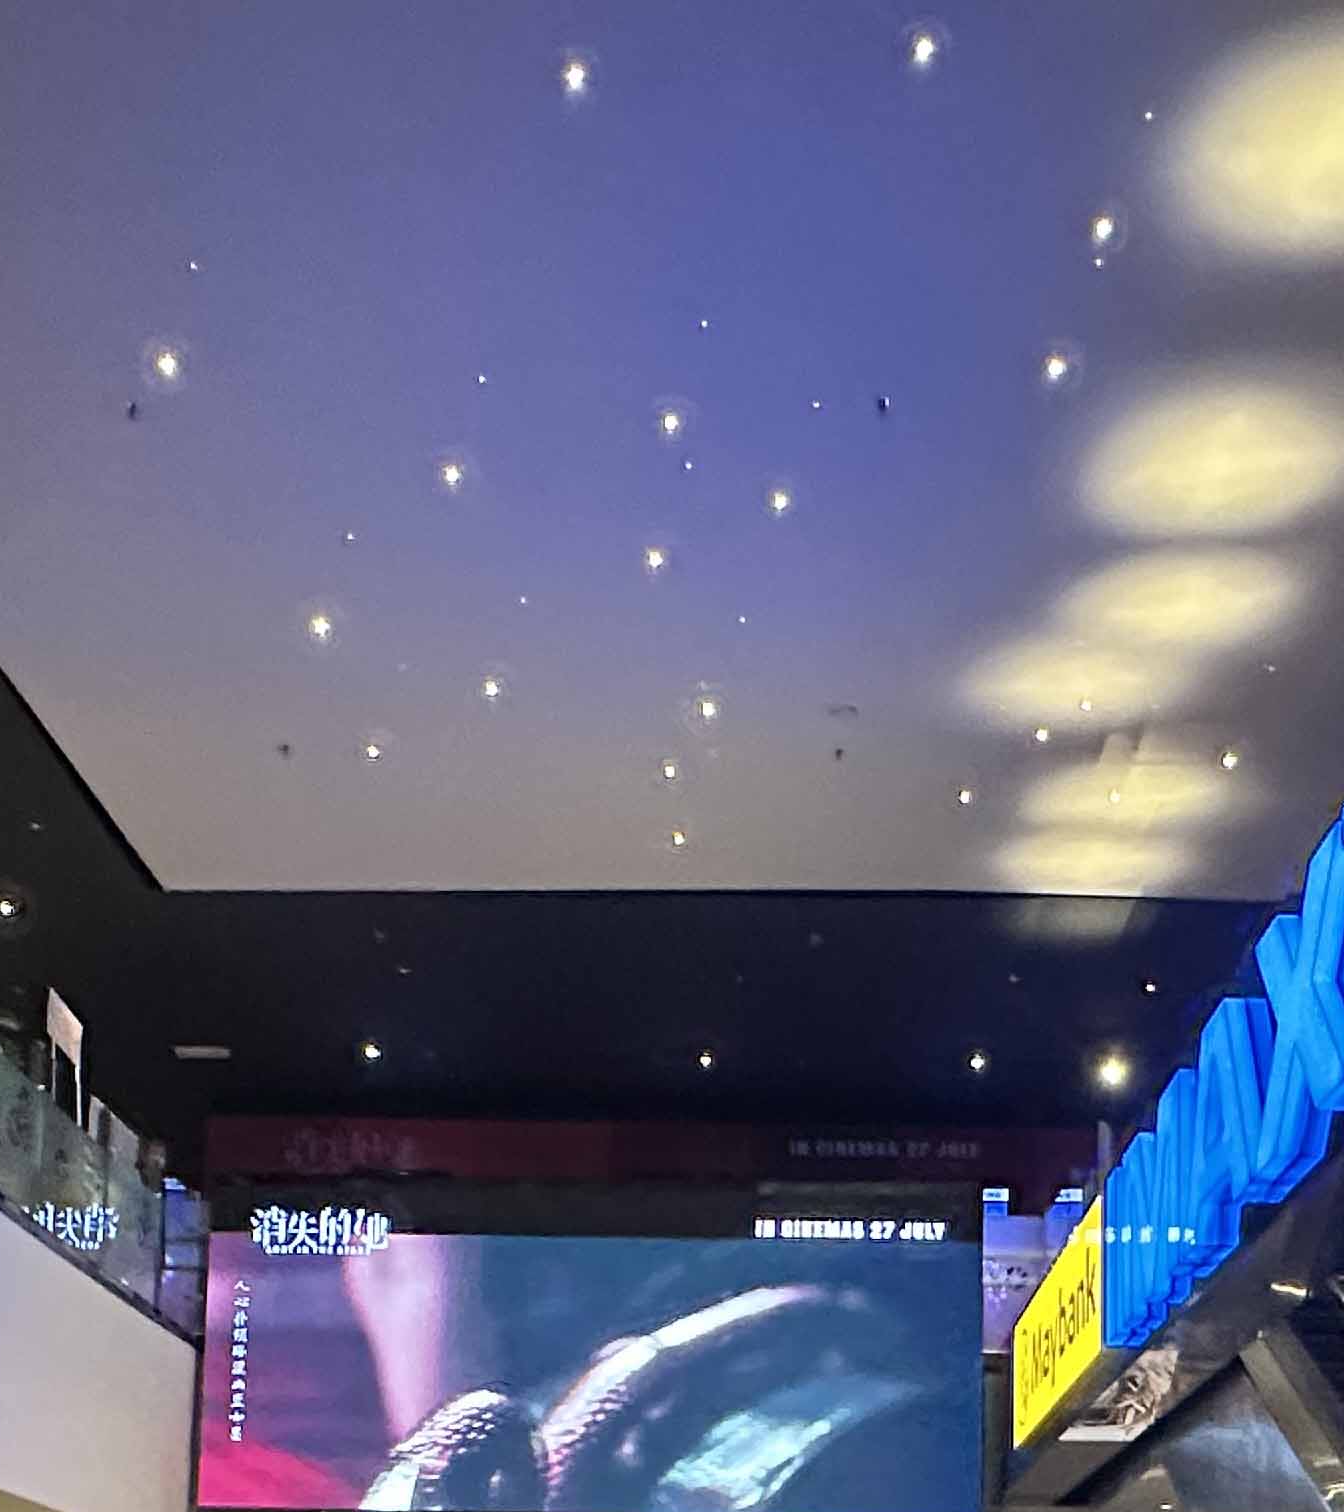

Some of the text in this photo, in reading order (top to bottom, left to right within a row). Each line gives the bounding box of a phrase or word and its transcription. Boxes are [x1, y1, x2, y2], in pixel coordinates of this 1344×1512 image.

[754, 1218, 946, 1241] IN CINEMAS 27 JULY
[1030, 1247, 1098, 1393] Maybank
